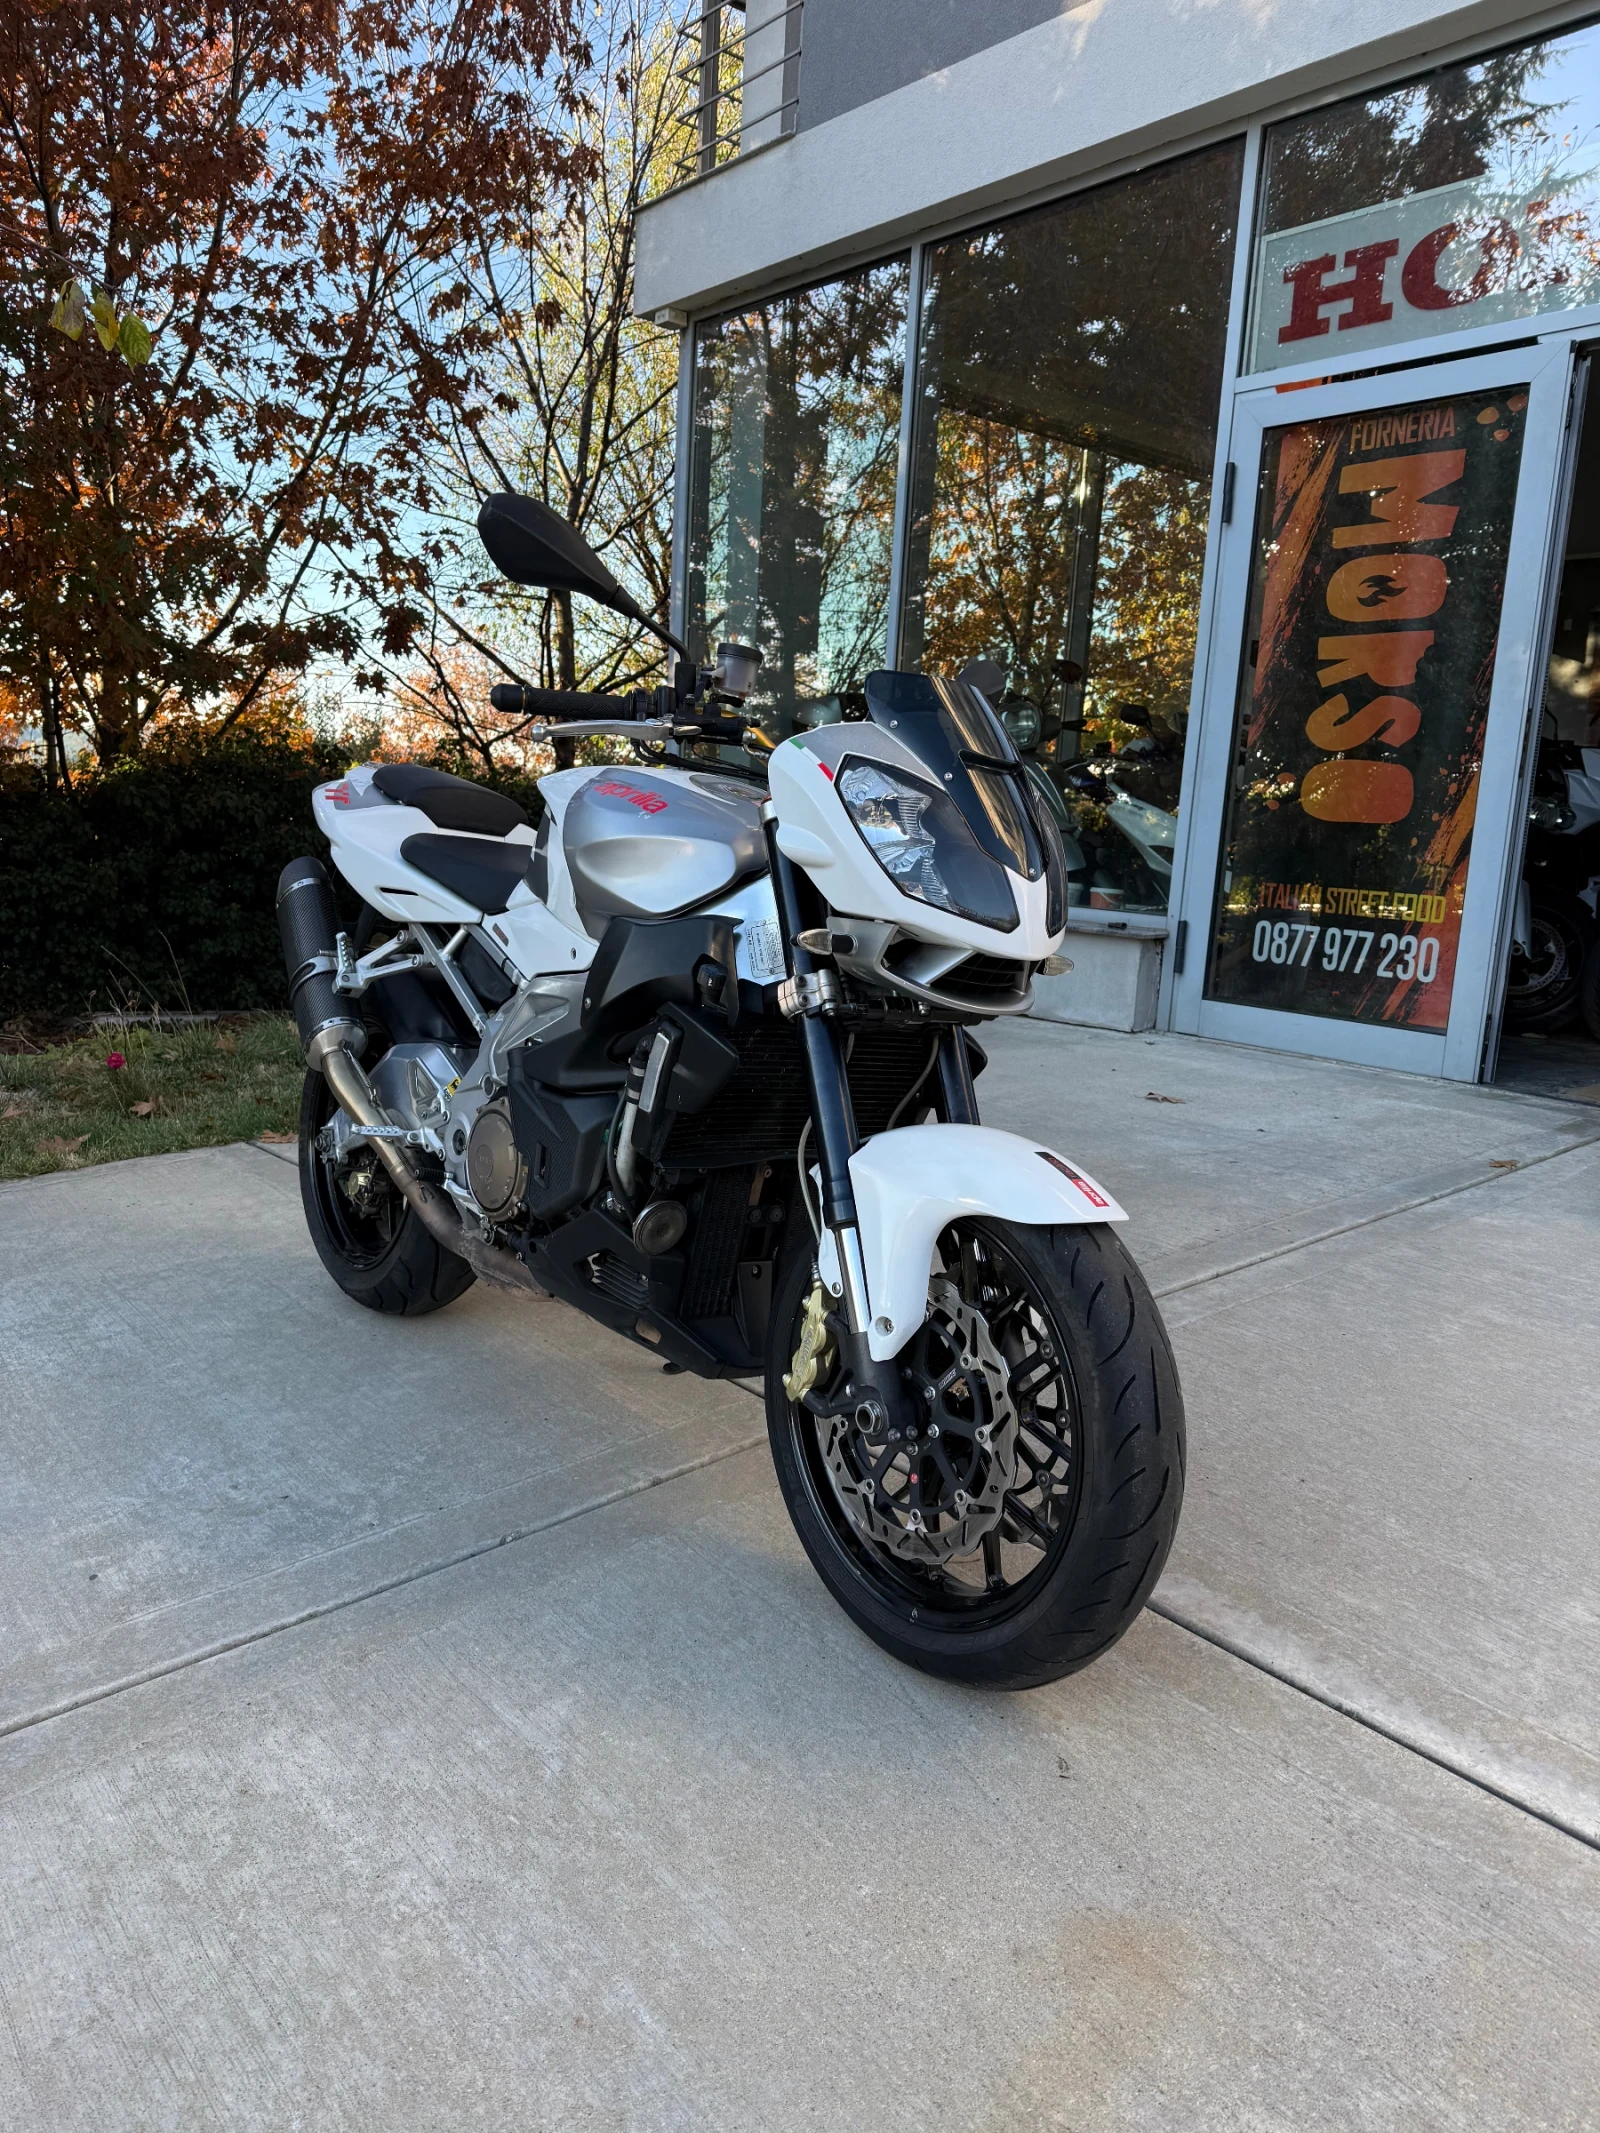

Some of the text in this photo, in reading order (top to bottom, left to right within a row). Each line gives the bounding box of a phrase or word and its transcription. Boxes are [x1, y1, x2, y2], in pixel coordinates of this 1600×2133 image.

[1350, 407, 1455, 452] FORNERIA
[1301, 449, 1466, 823] MORSO
[593, 782, 668, 814] aprilia
[1260, 882, 1446, 923] ITALIAN STREET FOOD
[1252, 920, 1440, 983] 0877 977 230
